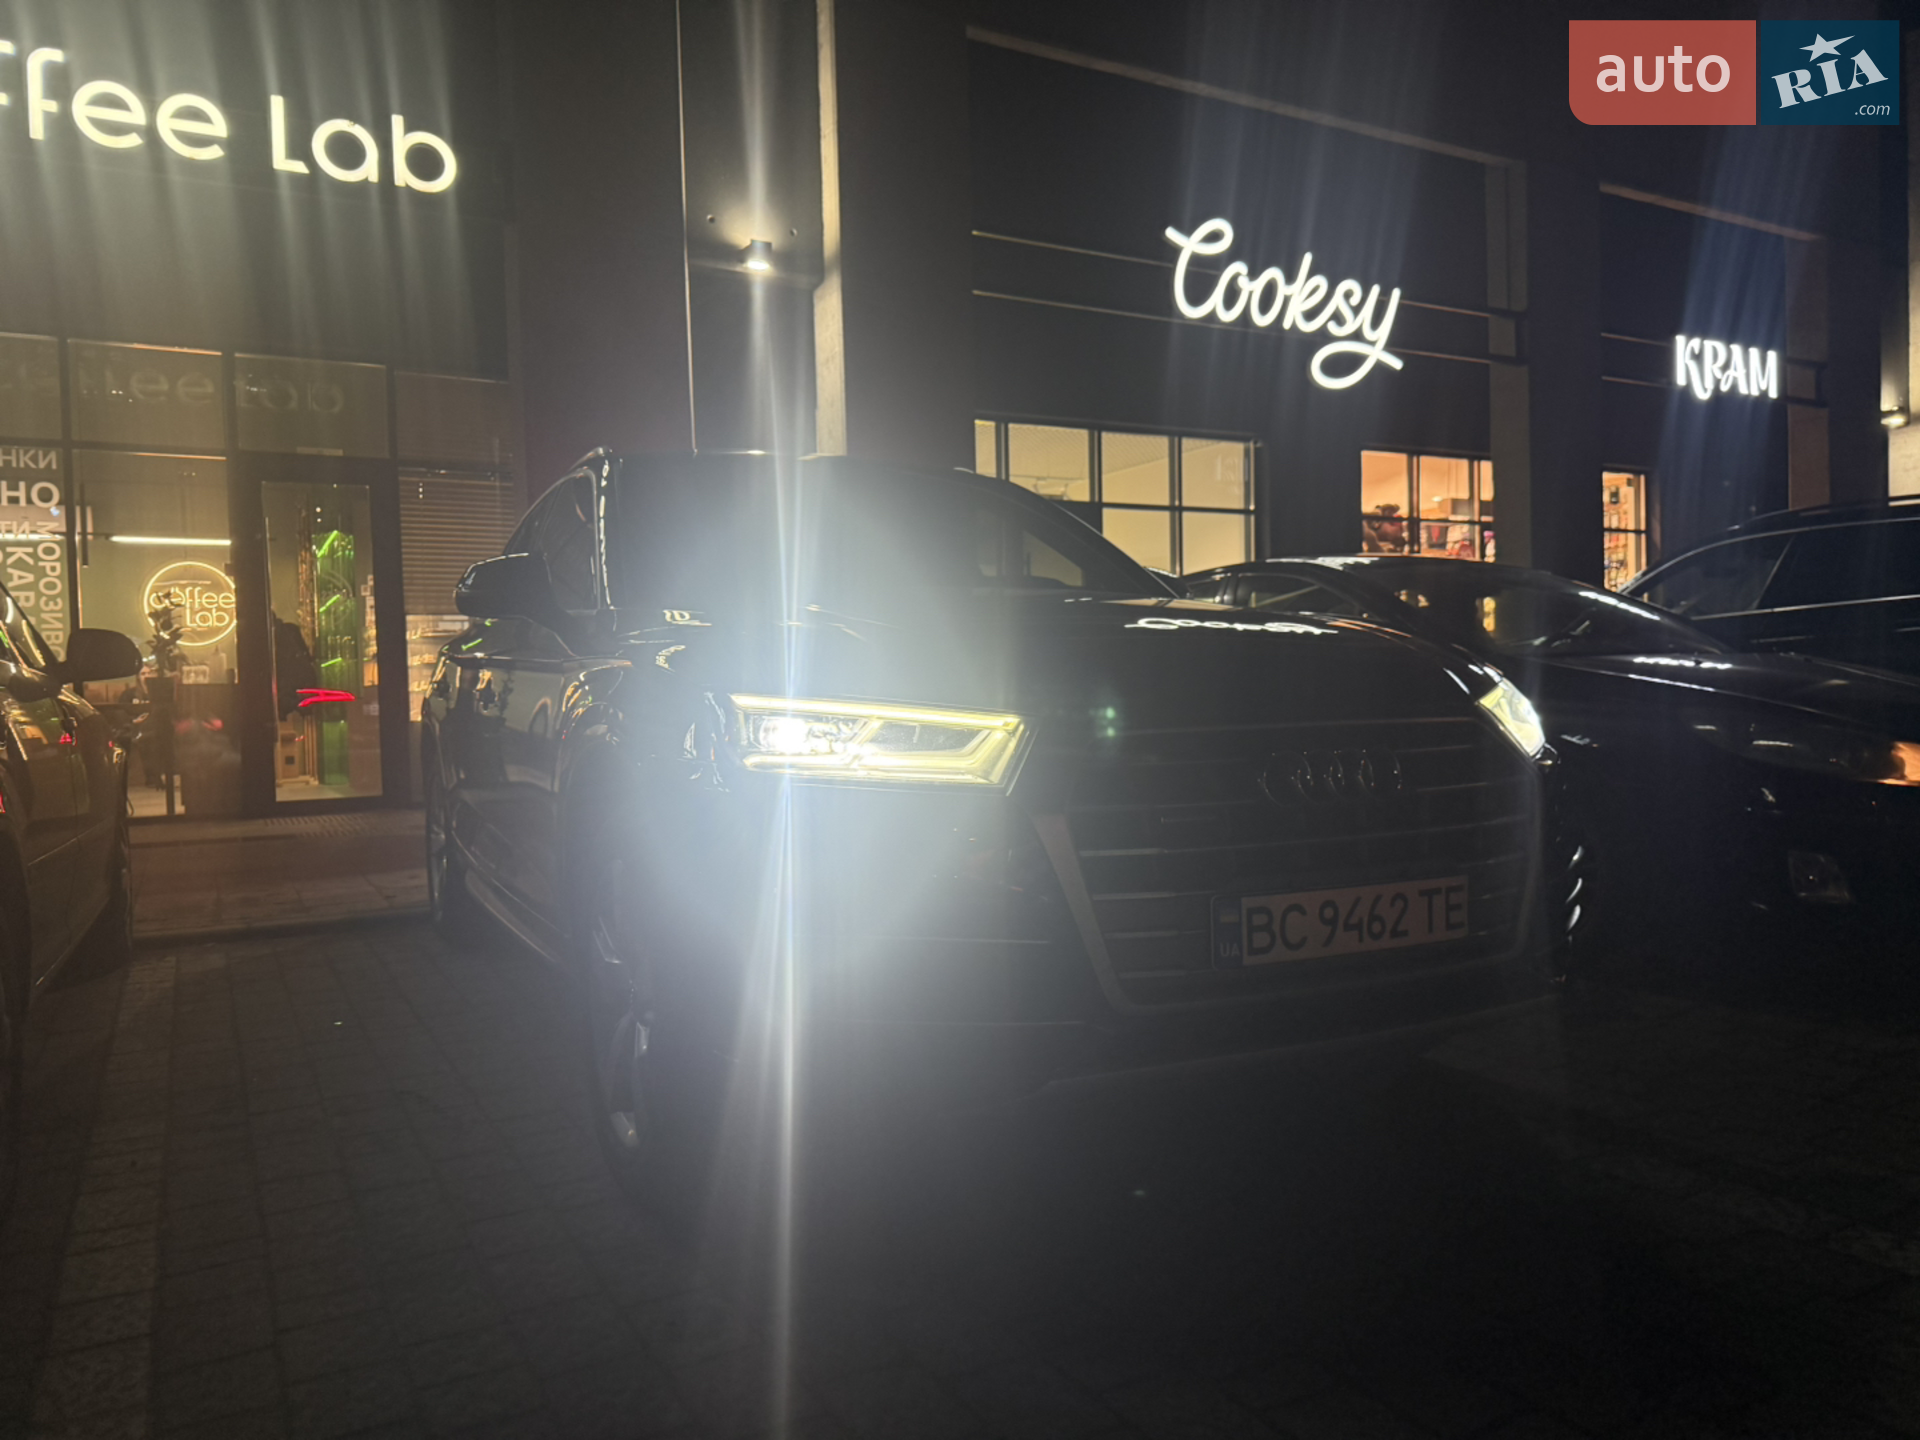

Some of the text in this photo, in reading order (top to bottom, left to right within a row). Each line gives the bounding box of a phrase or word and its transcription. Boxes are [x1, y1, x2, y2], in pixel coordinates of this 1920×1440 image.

[270, 94, 457, 193] Lab
[1165, 218, 1403, 389] Cooksy
[1675, 335, 1778, 400] KRAM
[6, 546, 37, 625] КАВ
[186, 600, 229, 627] Lab
[1246, 884, 1466, 957] BC 9462 TE
